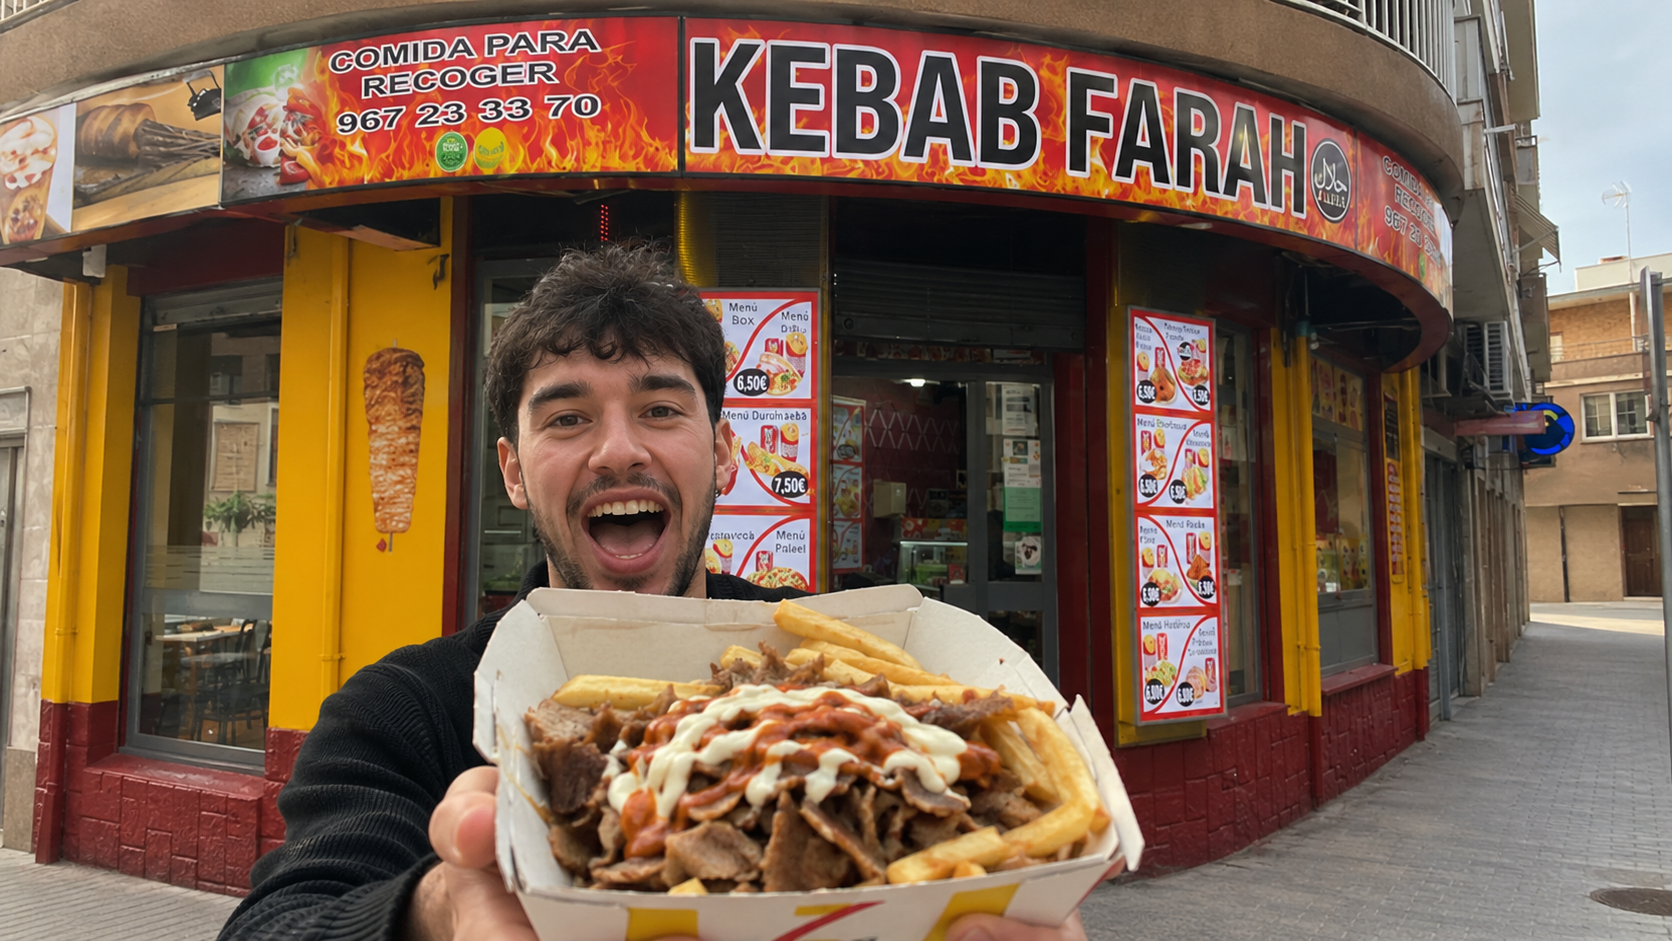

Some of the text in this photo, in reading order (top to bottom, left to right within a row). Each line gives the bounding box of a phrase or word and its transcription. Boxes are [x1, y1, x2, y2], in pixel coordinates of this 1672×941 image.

[329, 28, 601, 74] COMIDA PARA
[361, 61, 559, 99] RECOGER
[336, 94, 600, 135] 967 23 33 70
[689, 37, 1307, 219] KEBAB FARAH
[1384, 205, 1408, 236] 967
[731, 315, 755, 326] Box
[736, 375, 768, 392] 6,50€
[774, 477, 806, 494] 7,50€
[776, 530, 805, 540] Menú
